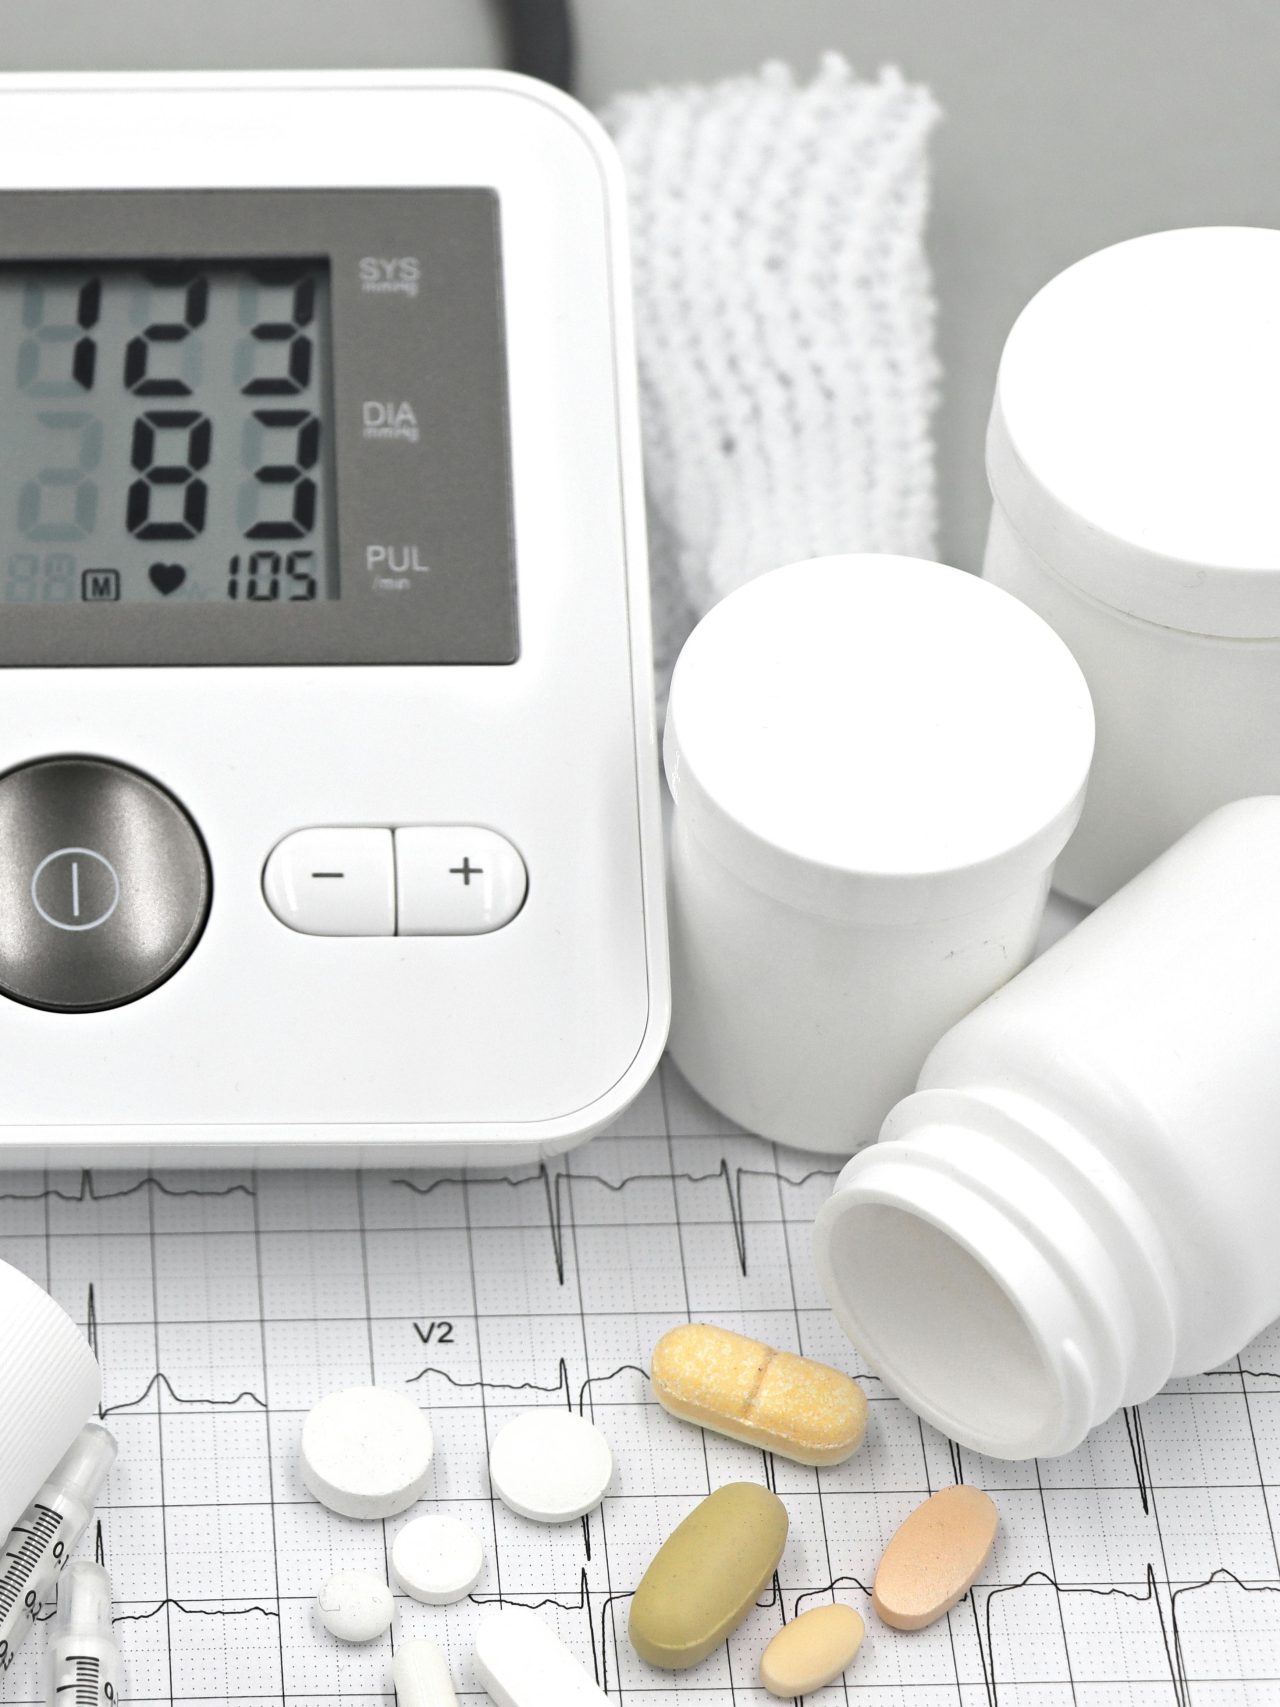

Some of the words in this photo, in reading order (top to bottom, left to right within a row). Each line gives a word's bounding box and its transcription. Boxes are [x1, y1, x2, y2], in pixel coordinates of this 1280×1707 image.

[359, 256, 421, 280] SYS
[72, 264, 317, 397] 123
[362, 400, 418, 426] DIA
[125, 410, 321, 541] 83
[366, 545, 430, 572] PUL
[227, 550, 318, 601] 105
[412, 1320, 455, 1344] V2
